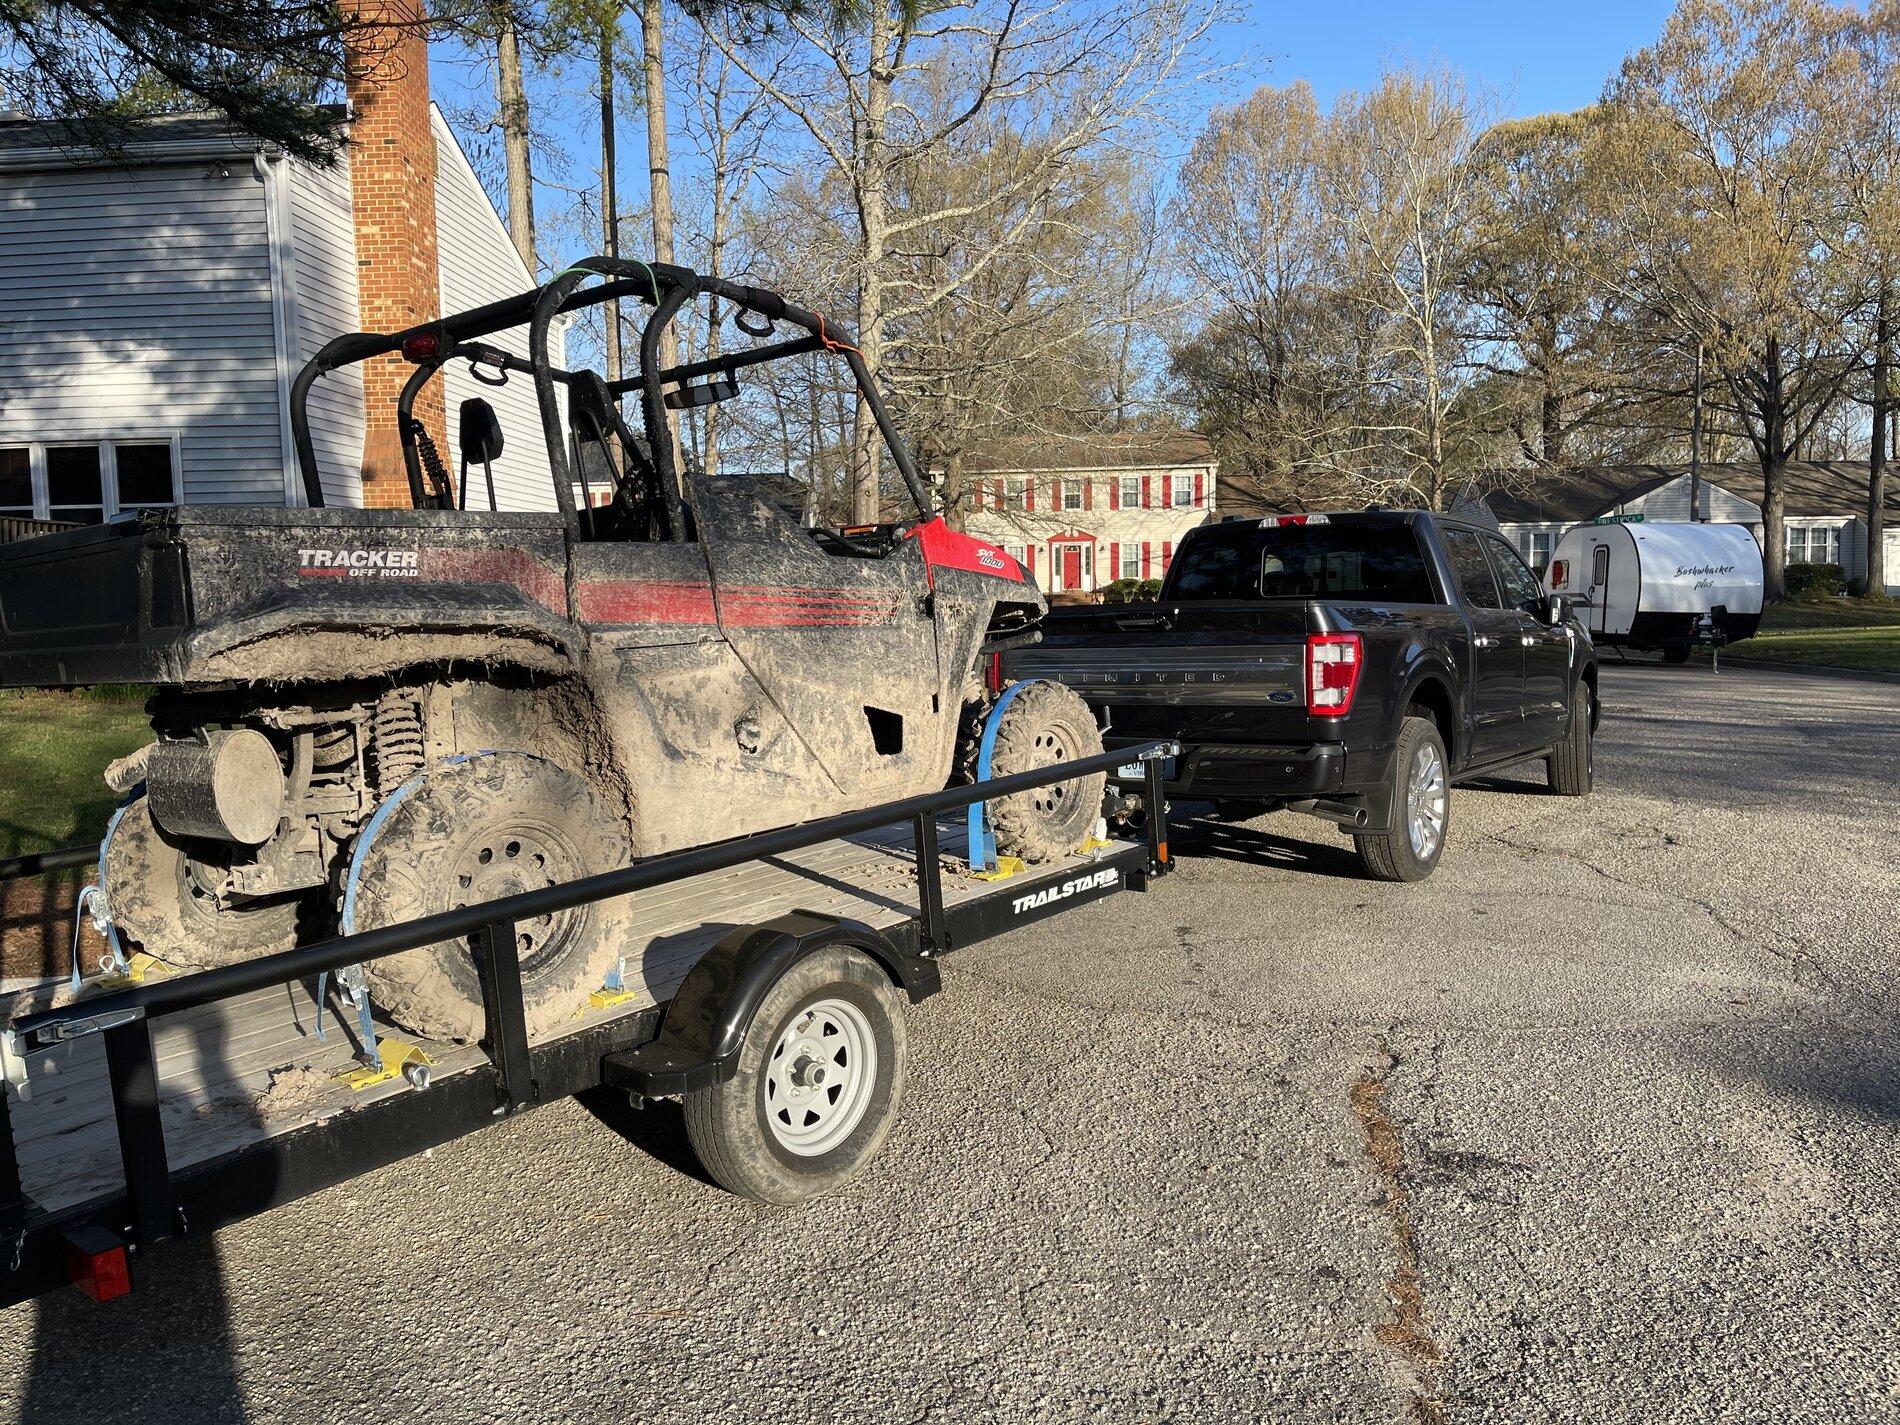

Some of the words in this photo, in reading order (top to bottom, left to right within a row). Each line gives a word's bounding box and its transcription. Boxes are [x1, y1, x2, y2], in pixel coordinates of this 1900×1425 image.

[1597, 515, 1636, 525] PRESTWICK
[297, 549, 419, 567] TRACKER
[981, 556, 1004, 569] 1000
[349, 568, 377, 577] OFF
[380, 568, 419, 577] ROAD
[1674, 564, 1735, 578] Bushwhacker
[1694, 578, 1714, 591] plus
[1058, 672, 1226, 683] LIMITED
[1012, 871, 1106, 914] TRAILSTAR
